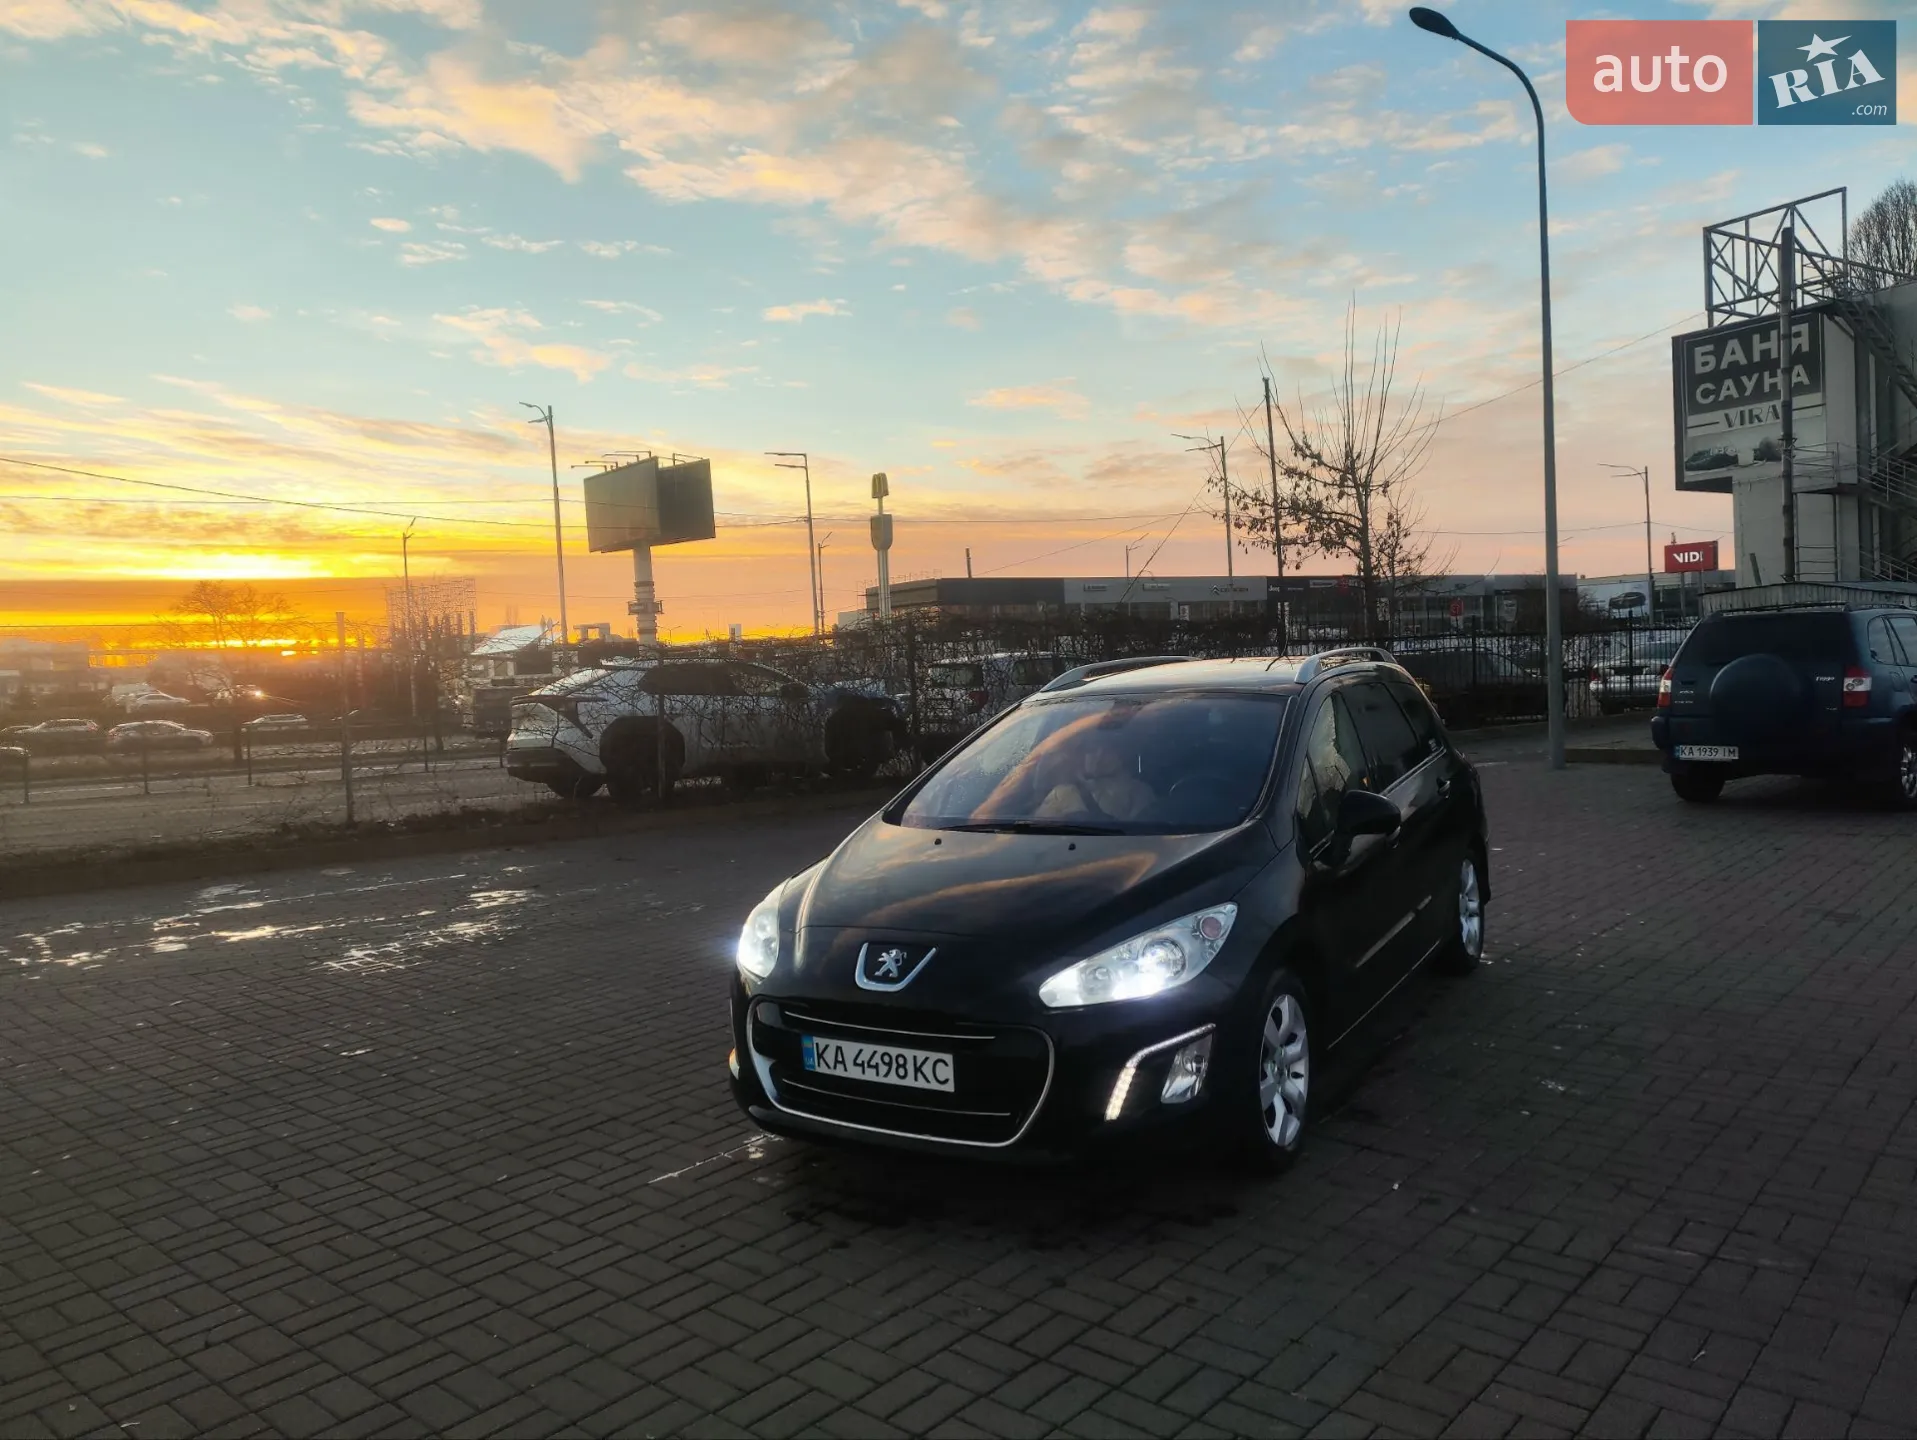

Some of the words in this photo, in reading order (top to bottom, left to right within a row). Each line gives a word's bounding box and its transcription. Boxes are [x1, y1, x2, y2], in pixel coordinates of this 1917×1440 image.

[1694, 323, 1809, 374] БАНЯ
[1695, 364, 1810, 404] САУНА
[1680, 746, 1694, 756] KA
[1697, 747, 1719, 757] 1939
[1723, 748, 1736, 757] IM
[815, 1042, 848, 1073] KA
[853, 1048, 908, 1080] 4498
[913, 1055, 950, 1085] KC
